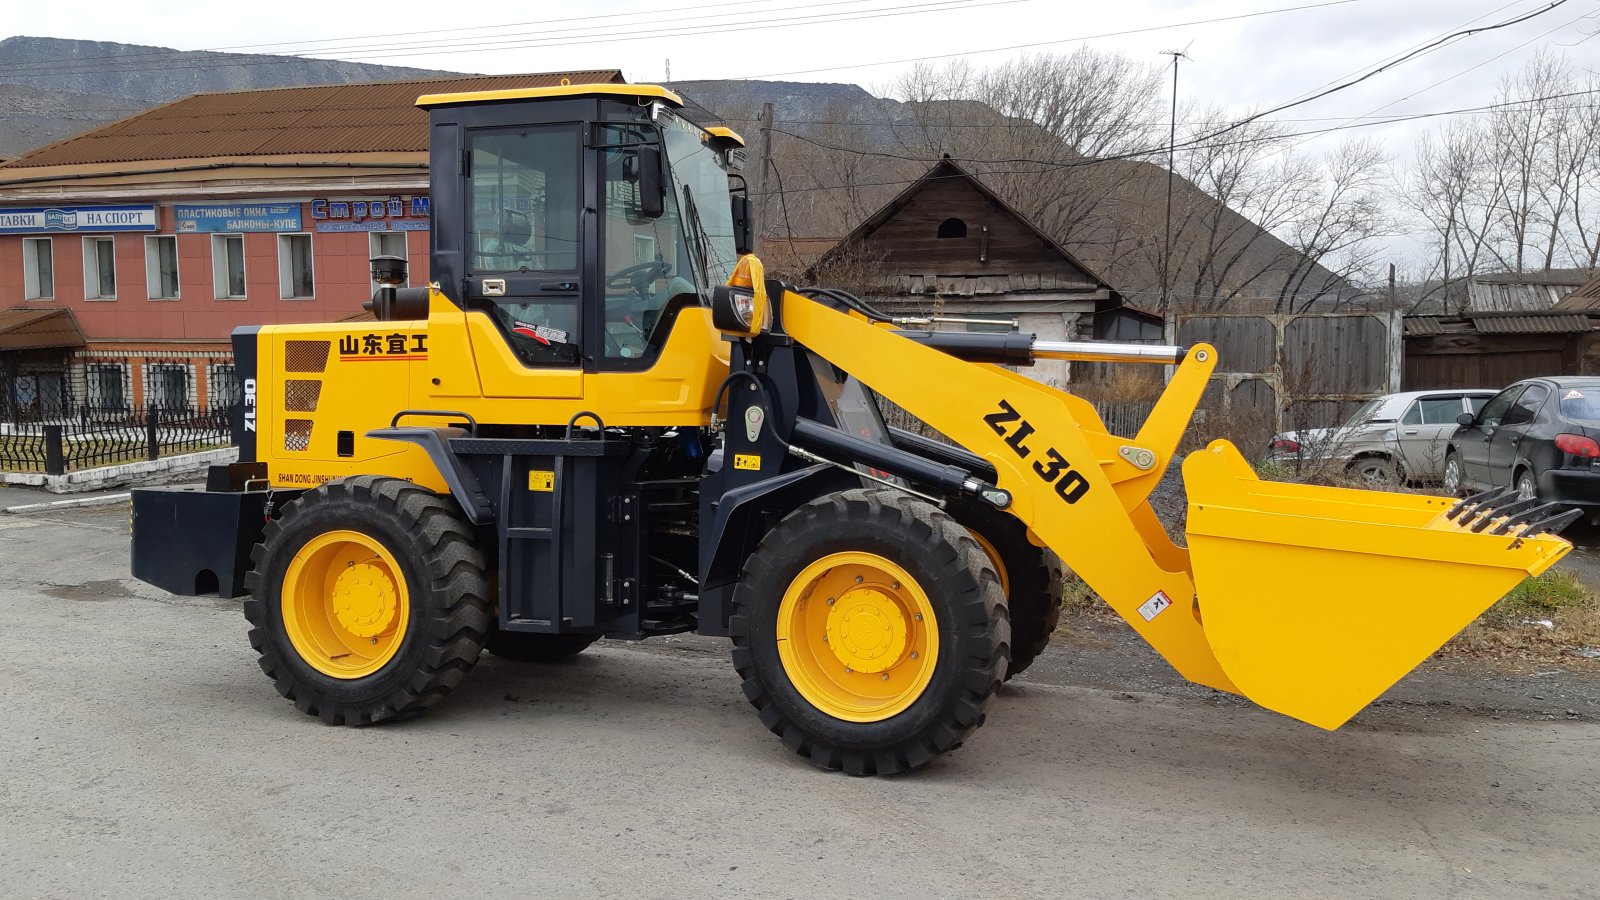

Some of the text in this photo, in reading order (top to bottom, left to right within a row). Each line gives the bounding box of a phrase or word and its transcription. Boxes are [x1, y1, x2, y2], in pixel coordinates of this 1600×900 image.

[178, 207, 241, 218] ПЛАСТИКОВЫЕ
[243, 207, 268, 217] ОКНА
[311, 196, 403, 221] Строй
[0, 215, 36, 226] ТАВКИ
[87, 213, 102, 224] НА
[105, 212, 143, 224] СПОРТ
[226, 219, 297, 229] БАЛКОНЫ-КУПЕ
[339, 333, 428, 355] 山东宜工
[244, 378, 256, 432] ZL30
[278, 473, 294, 483] SHAN
[295, 474, 311, 484] DONG
